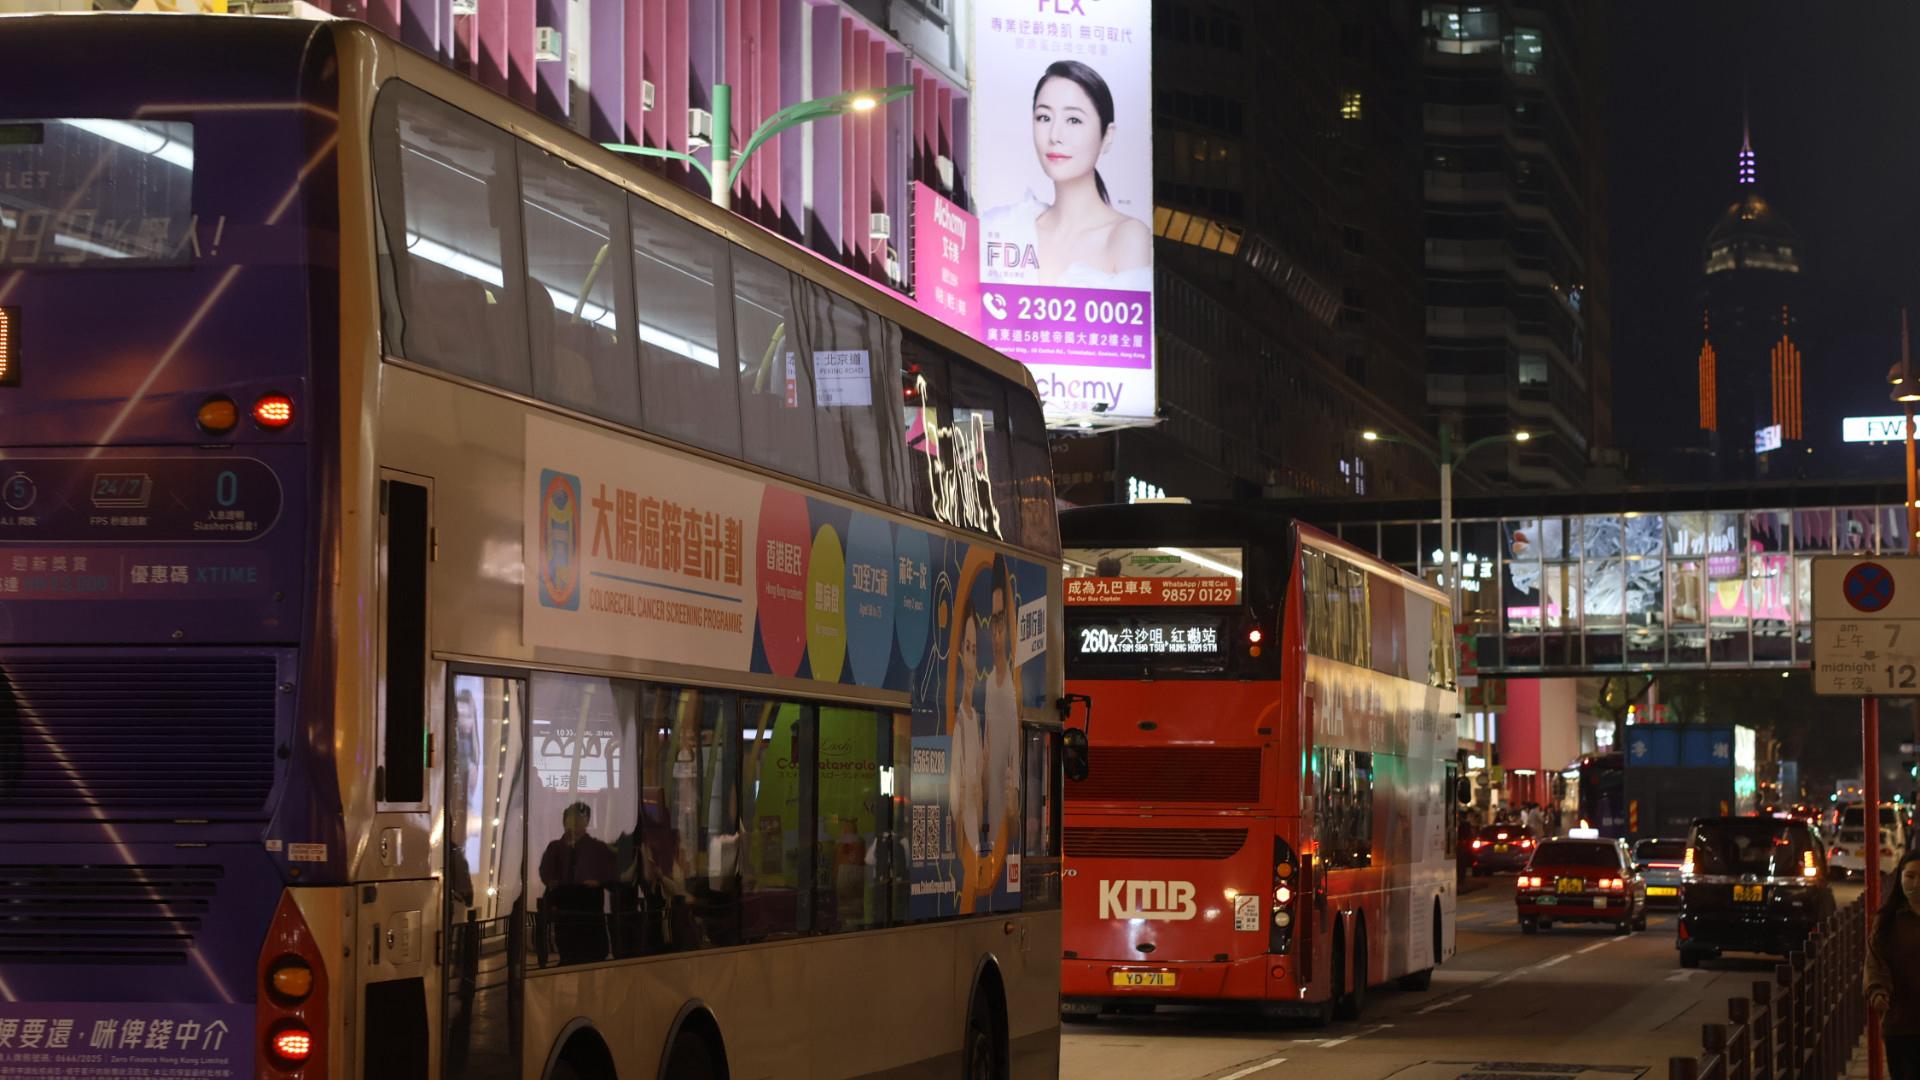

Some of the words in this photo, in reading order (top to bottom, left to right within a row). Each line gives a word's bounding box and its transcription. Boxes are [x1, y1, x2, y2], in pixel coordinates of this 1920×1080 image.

[1079, 25, 1134, 44] 無可取代
[0, 170, 51, 190] LET
[934, 195, 967, 252] Alchemy
[986, 241, 1040, 270] FDA
[1017, 296, 1077, 322] 2302
[1084, 300, 1144, 325] 0002
[824, 353, 861, 366] 北京道
[1036, 372, 1124, 412] chemy
[13, 480, 25, 499] 5
[96, 478, 141, 496] 24/7
[216, 470, 238, 507] 0
[89, 516, 109, 527] FPS
[591, 482, 743, 587] 大腸癌篩查計劃
[767, 539, 803, 577] 香港居民
[130, 565, 189, 584] 優惠碼
[852, 563, 888, 597] 50至75歲
[898, 555, 927, 592] 兩年一次
[1067, 580, 1153, 595] 成為九巴車長
[1162, 580, 1197, 589] WhatsApp
[1076, 595, 1087, 603] Our
[1088, 595, 1099, 603] Bus
[1099, 595, 1121, 604] Captain
[1161, 588, 1195, 603] 9857
[1198, 588, 1233, 603] 0129
[589, 587, 637, 618] COLORECTAL
[637, 595, 665, 621] CANCER
[665, 600, 703, 628] SCREENING
[703, 606, 743, 634] PROGRAMME
[1832, 633, 1865, 649] 上午
[1839, 623, 1859, 633] am
[1883, 623, 1902, 649] 7
[1118, 644, 1134, 653] TSIM
[1135, 644, 1148, 653] SHA
[1149, 643, 1165, 653] TSUI
[1168, 644, 1187, 653] HUNG
[1187, 644, 1203, 653] HOM
[1203, 644, 1218, 653] STN
[1820, 661, 1877, 675] midnight
[1885, 664, 1918, 689] 12
[1832, 676, 1865, 690] 午夜
[913, 748, 931, 775] 3565
[1099, 879, 1197, 921] KMB
[1126, 973, 1143, 985] YD
[1148, 973, 1164, 985] 711
[129, 1056, 158, 1064] Finance
[159, 1056, 179, 1065] Hong
[180, 1057, 199, 1066] Kong
[200, 1057, 229, 1065] Limited
